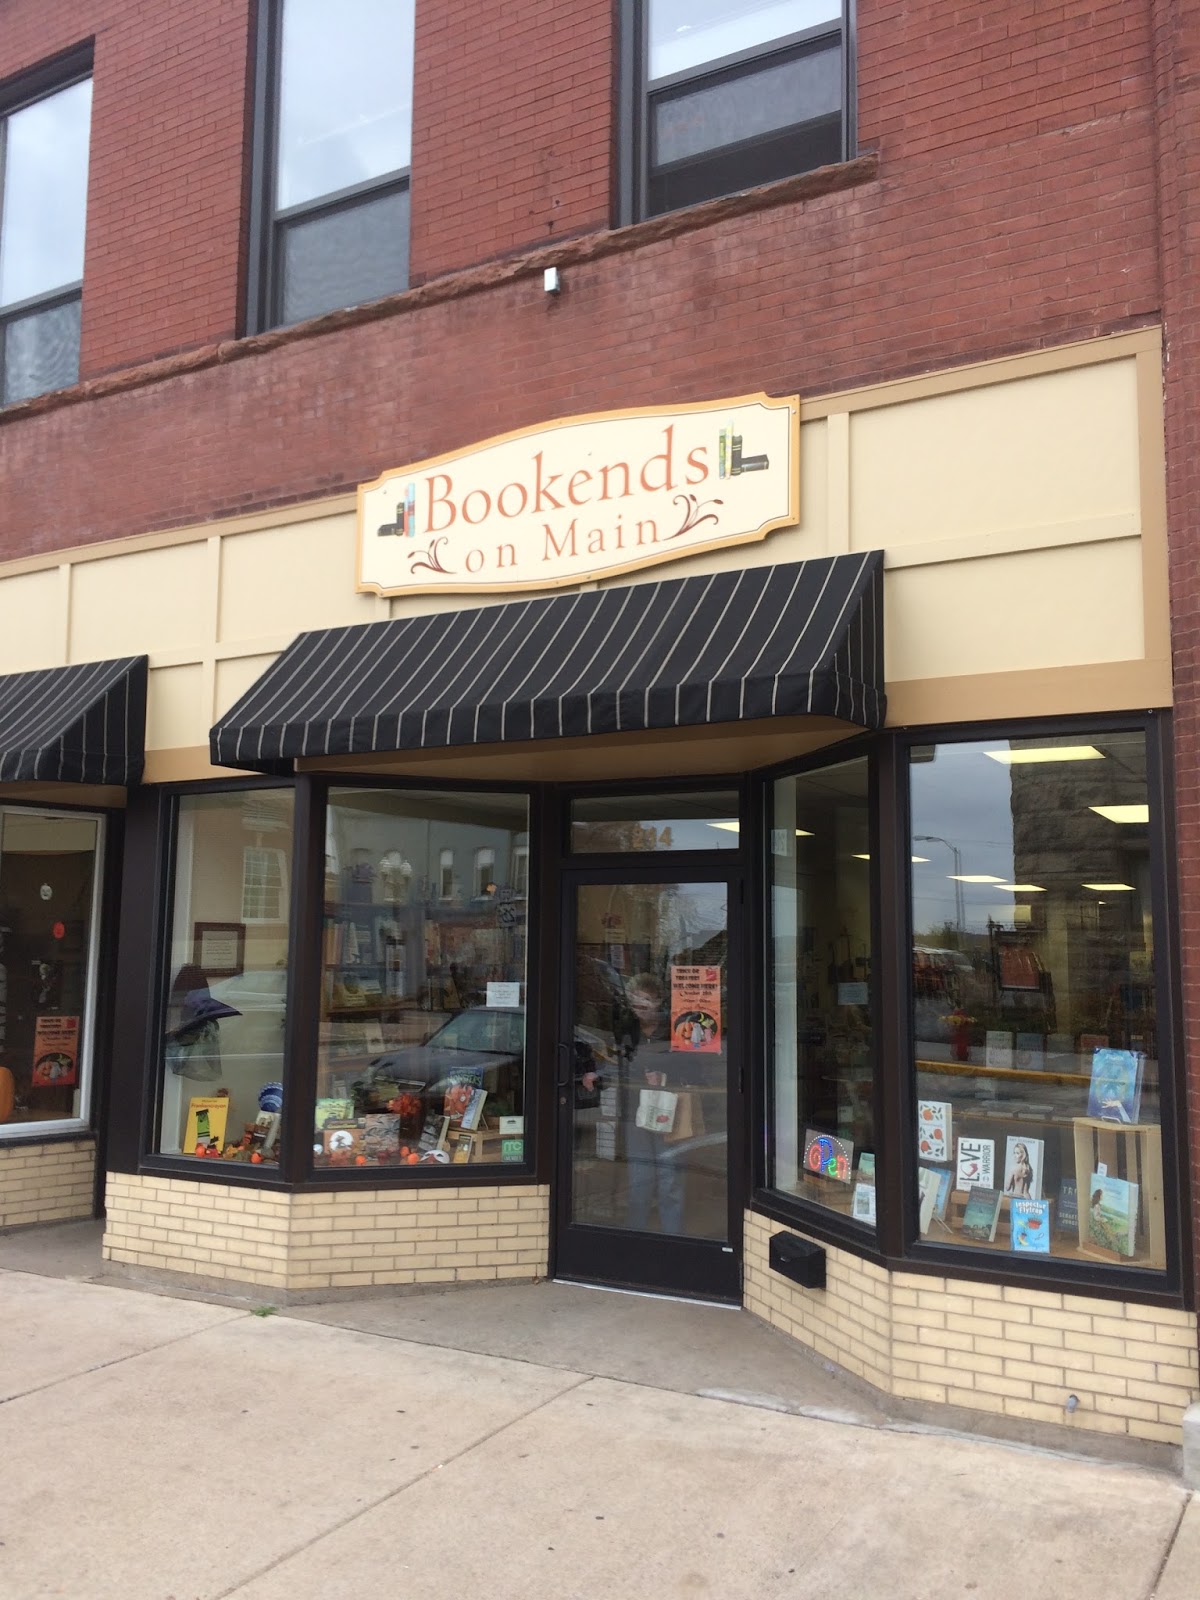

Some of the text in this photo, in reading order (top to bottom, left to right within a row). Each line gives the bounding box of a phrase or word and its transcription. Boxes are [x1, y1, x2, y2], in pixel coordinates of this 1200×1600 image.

[423, 423, 710, 534] Bookends
[465, 513, 659, 573] on Main
[981, 1144, 992, 1175] WARRIOR
